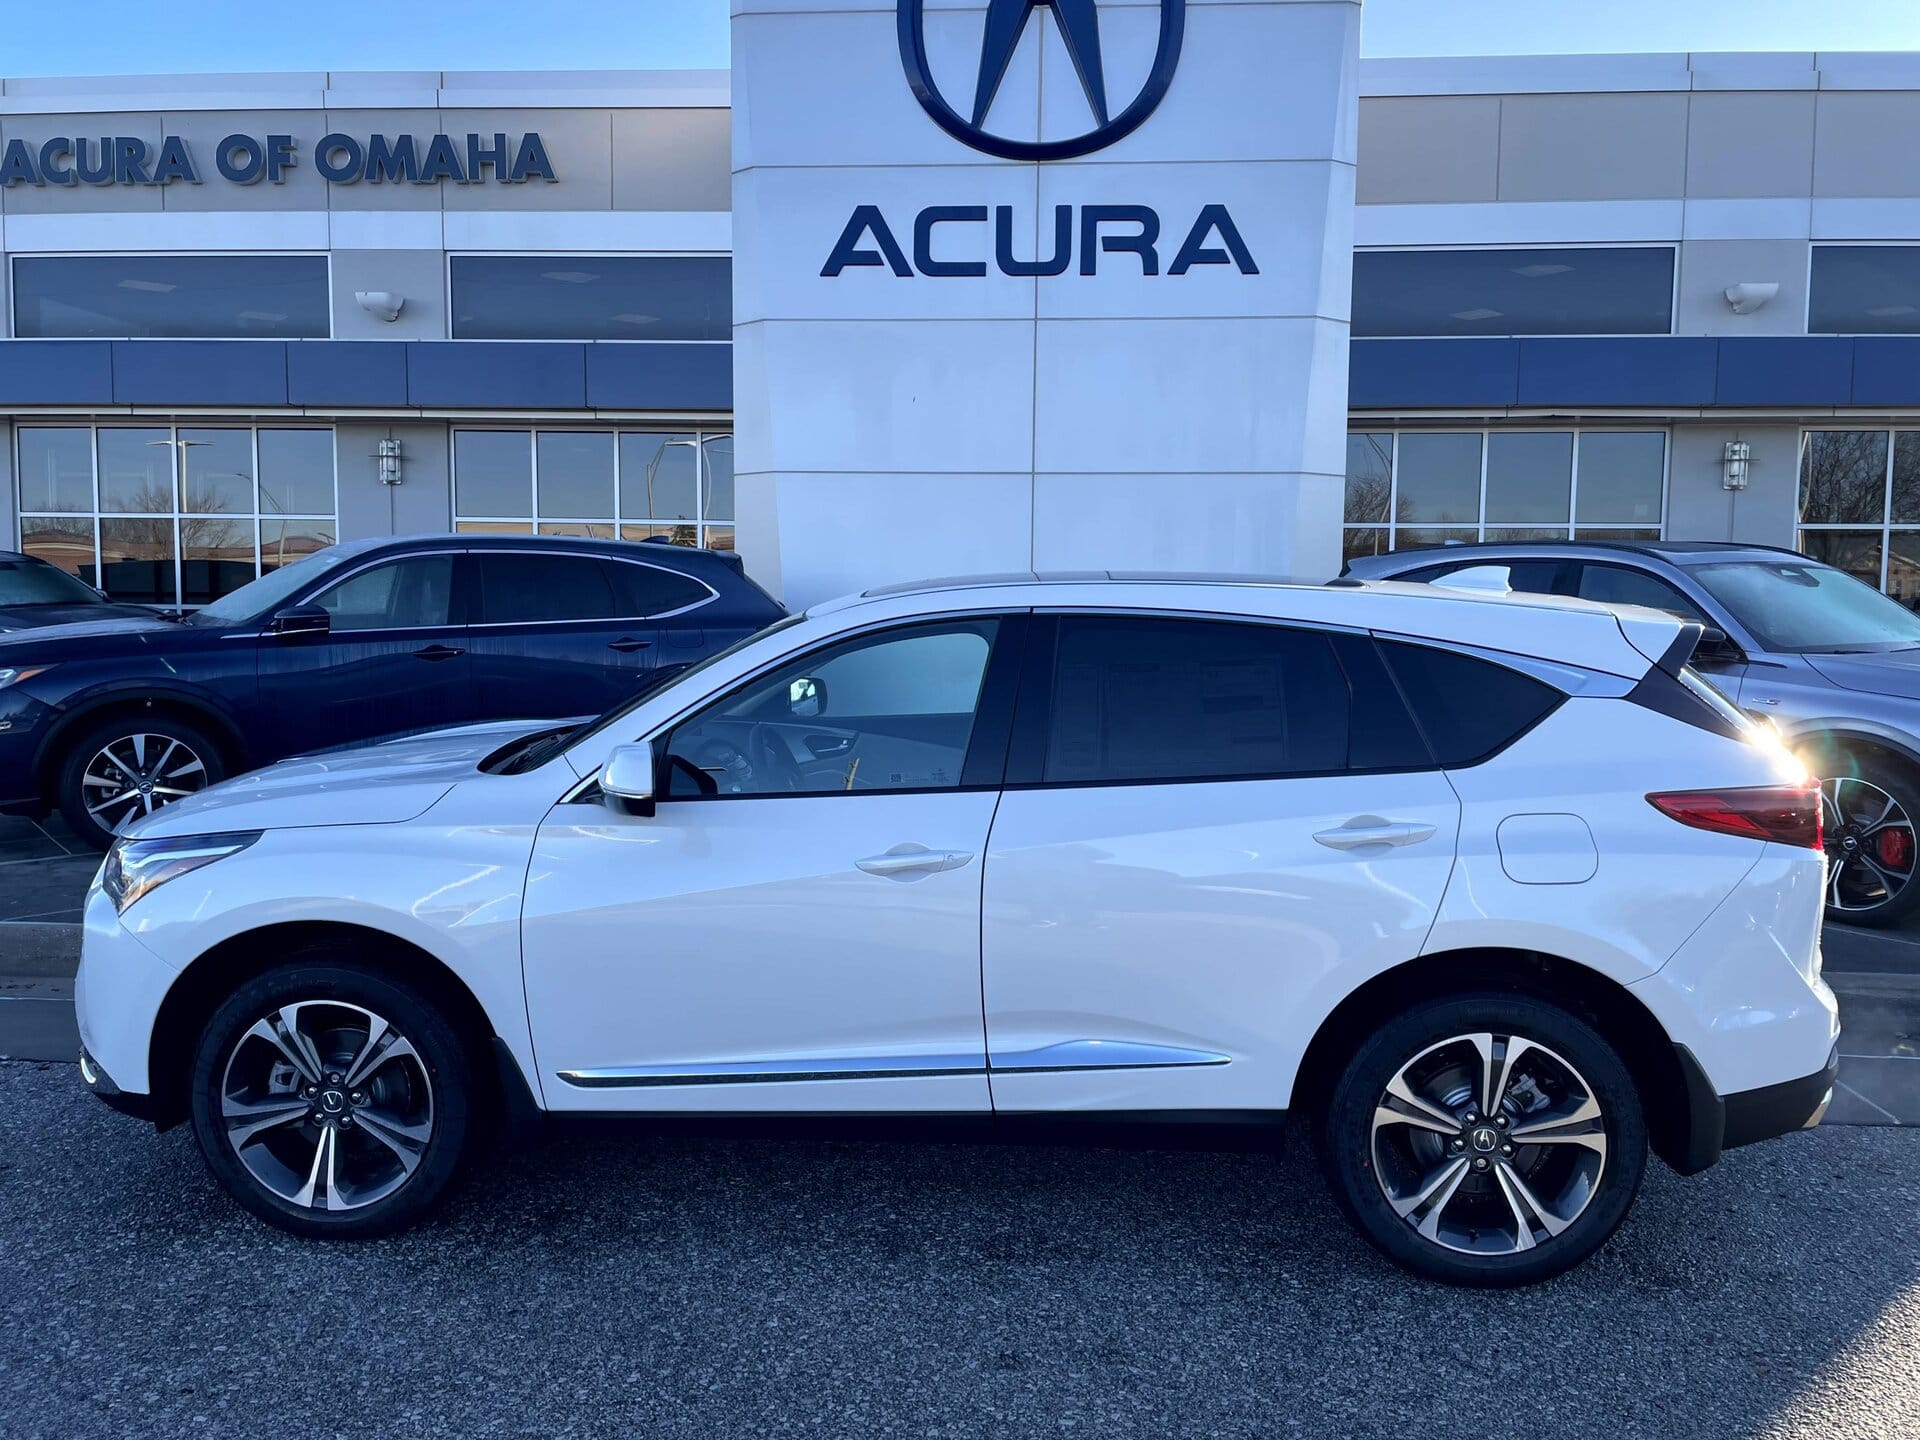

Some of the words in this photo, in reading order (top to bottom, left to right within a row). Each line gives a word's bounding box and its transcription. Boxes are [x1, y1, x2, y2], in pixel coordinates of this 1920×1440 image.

[0, 136, 200, 186] ACURA
[216, 134, 298, 184] OF
[315, 133, 557, 183] OMAHA
[820, 205, 1259, 277] ACURA
